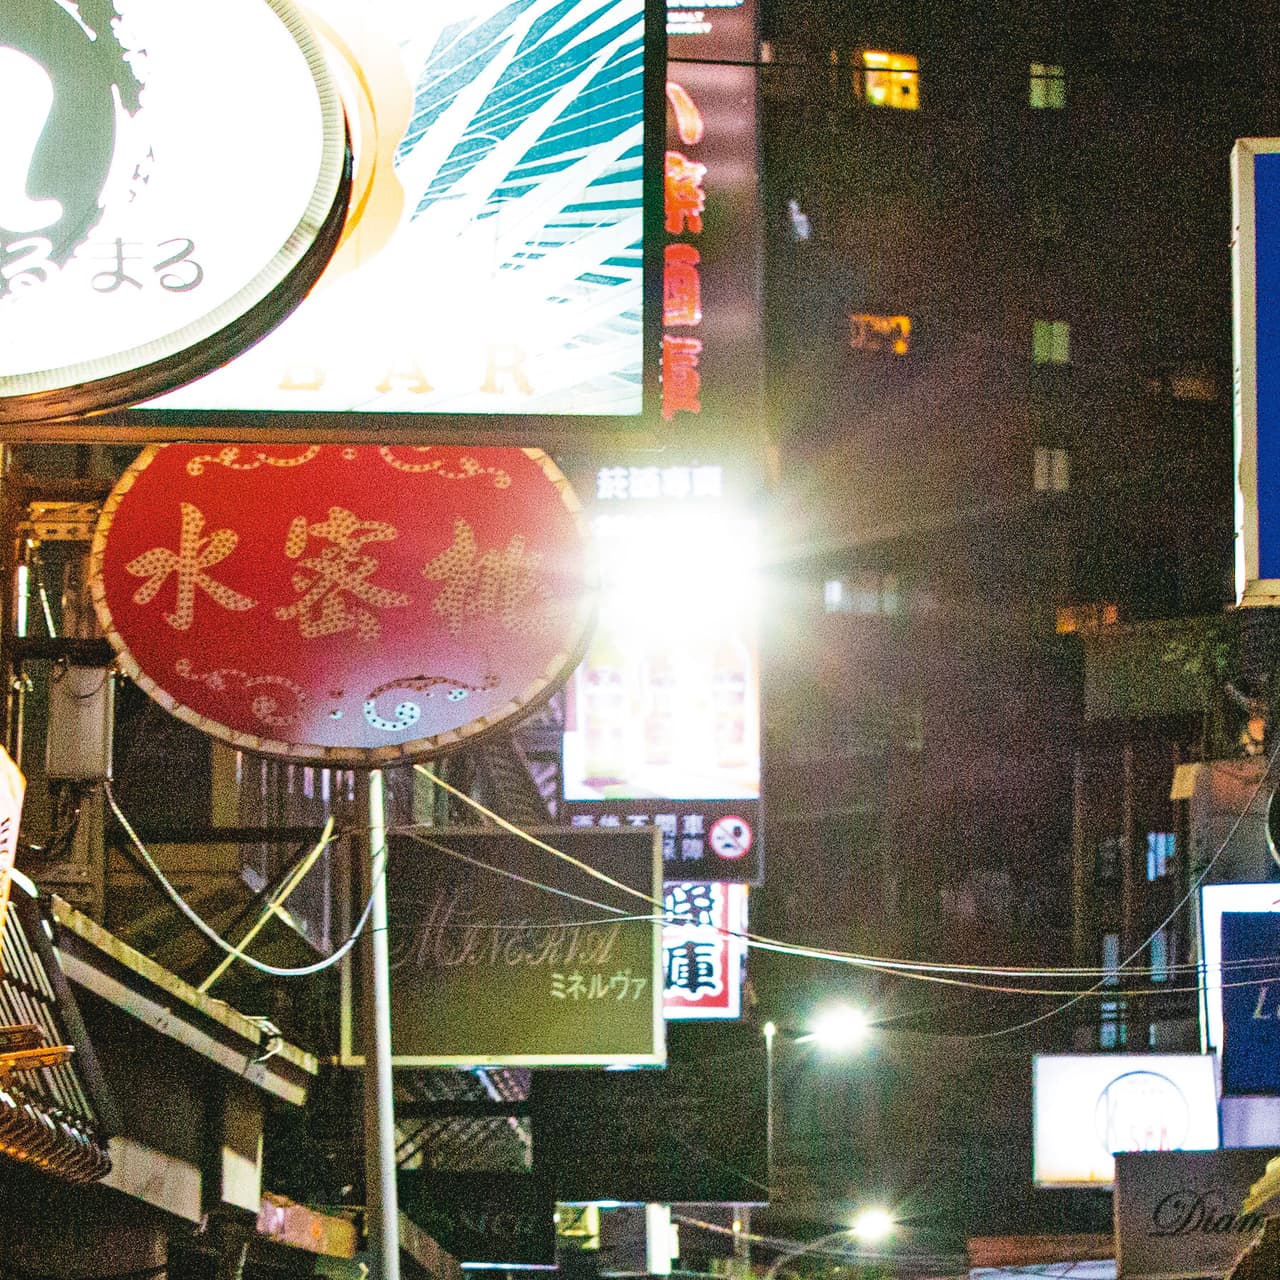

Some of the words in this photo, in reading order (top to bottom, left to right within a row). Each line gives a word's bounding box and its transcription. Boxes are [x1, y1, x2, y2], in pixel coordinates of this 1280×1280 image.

[551, 969, 647, 1001] ミネルヴァ
